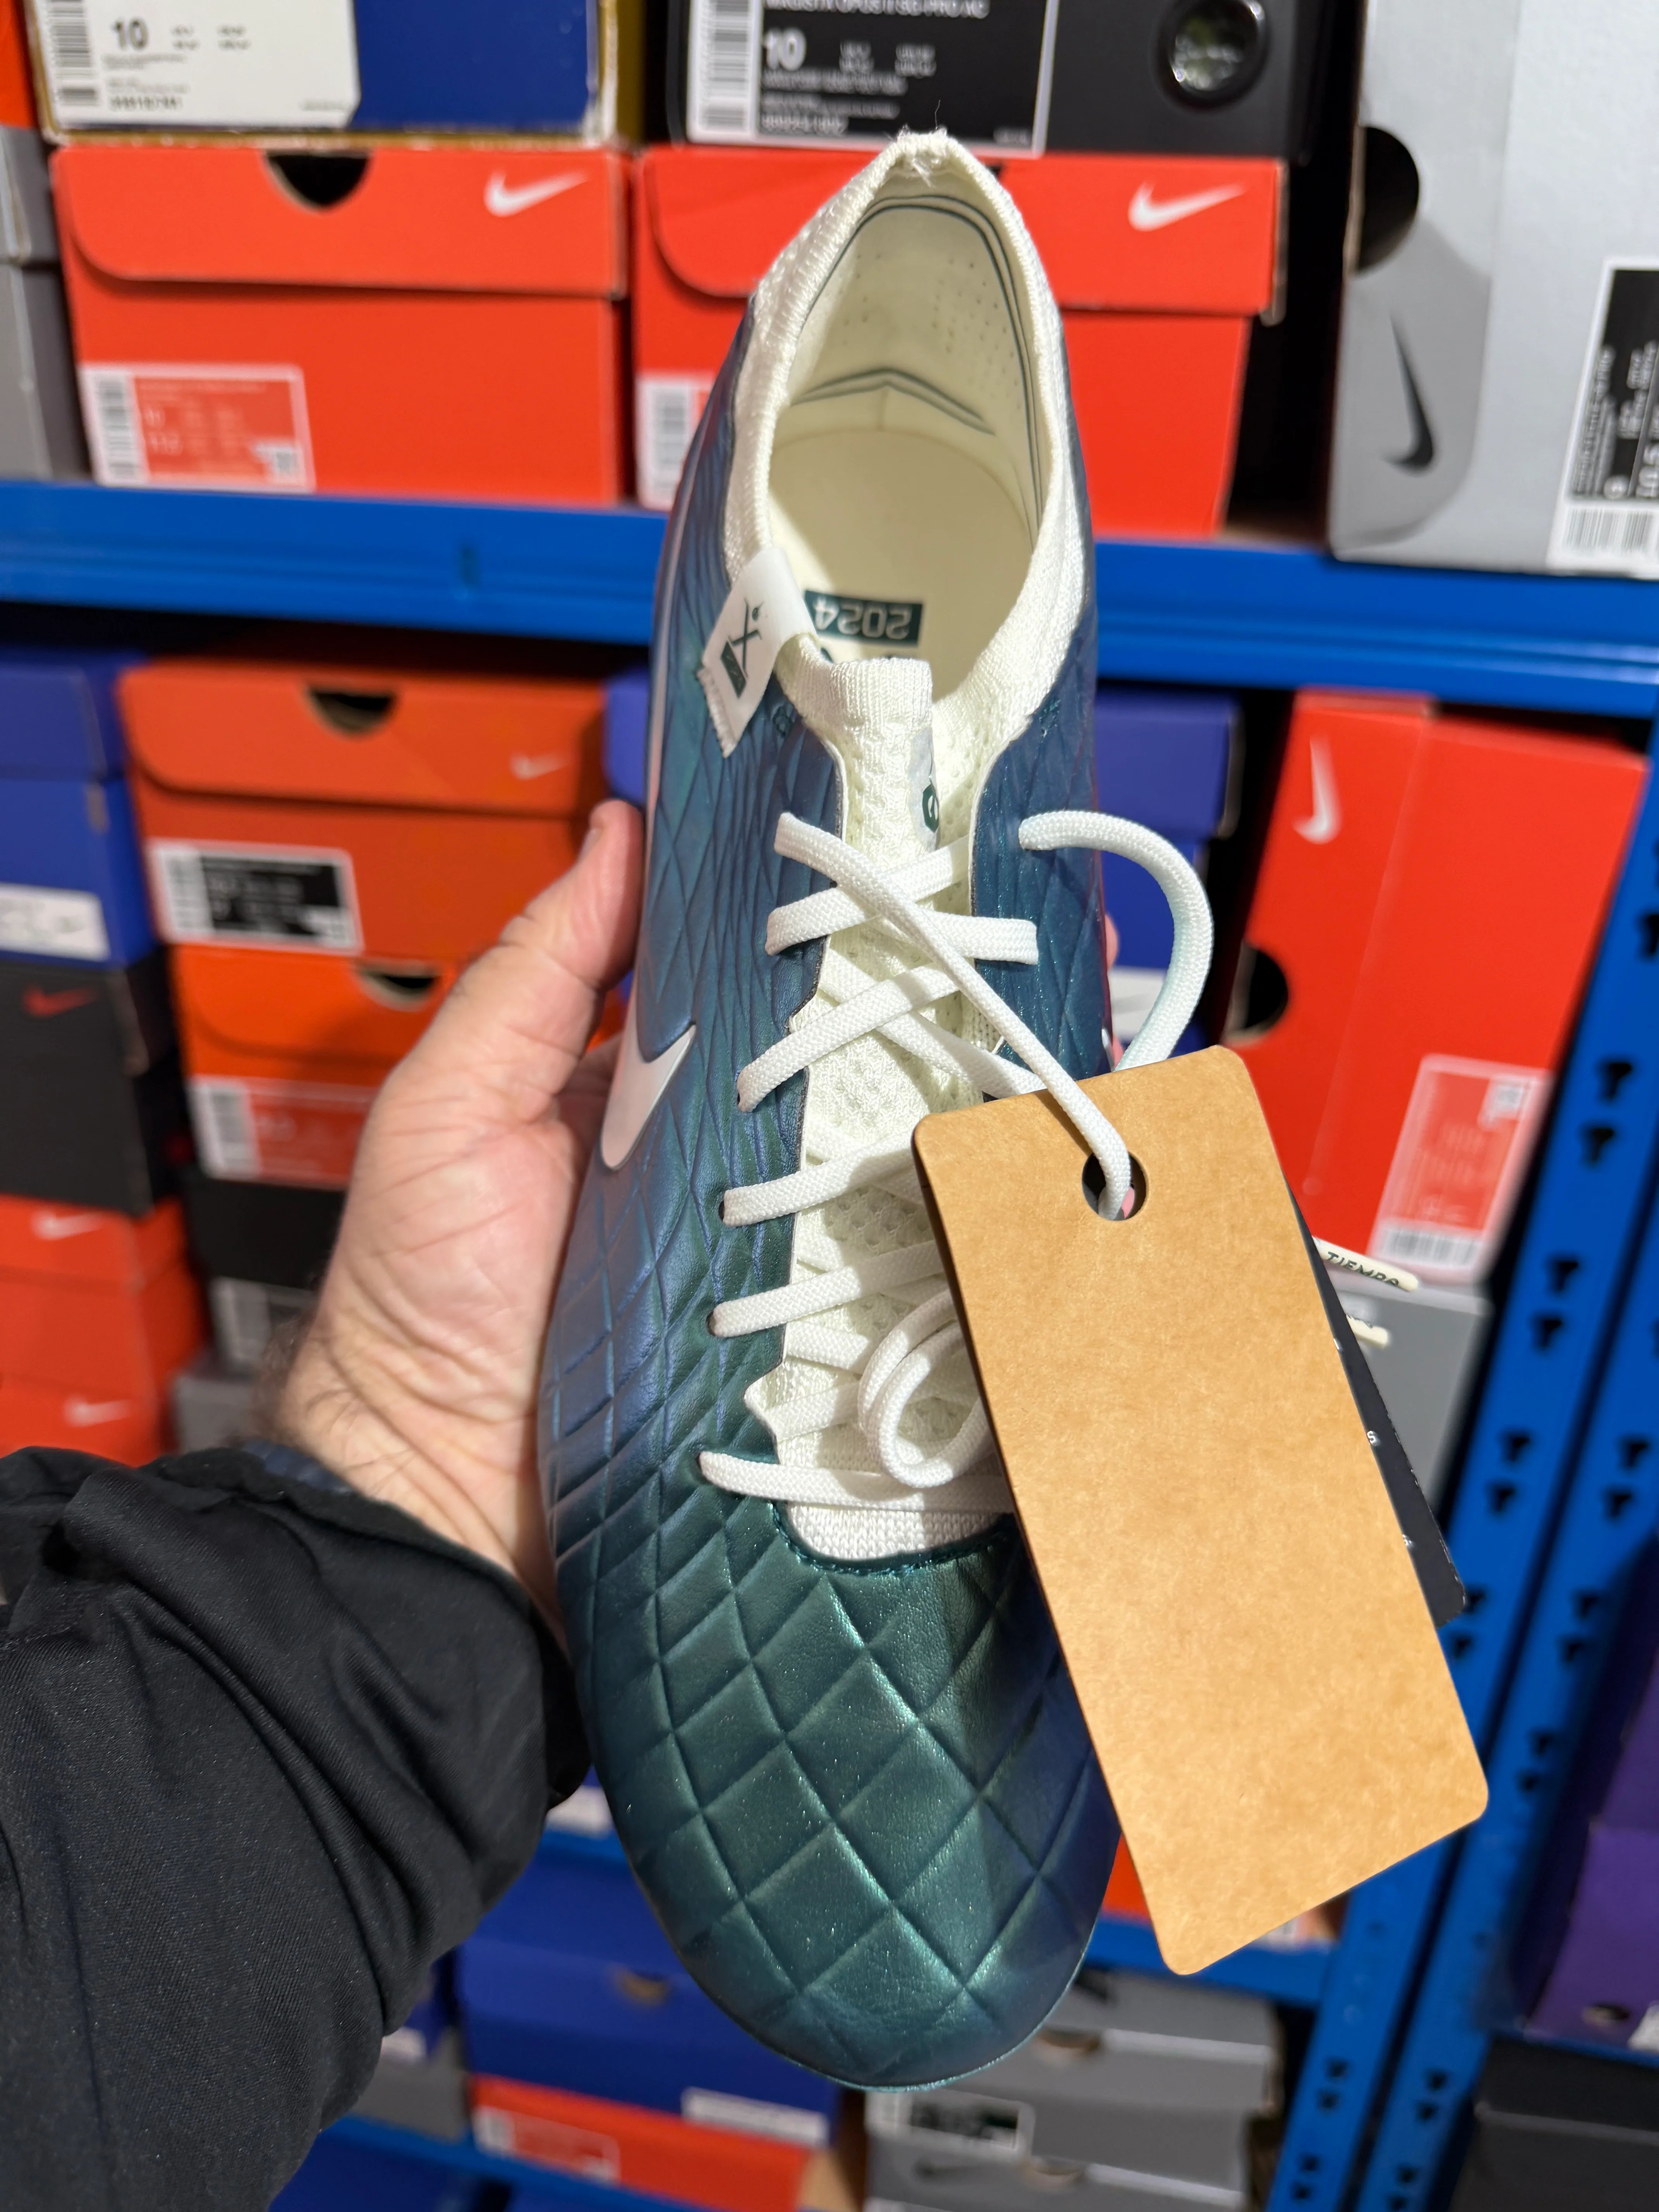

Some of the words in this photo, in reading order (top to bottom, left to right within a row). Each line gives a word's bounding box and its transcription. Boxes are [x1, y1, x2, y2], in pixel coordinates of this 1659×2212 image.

[113, 18, 149, 50] 10
[763, 28, 807, 71] 10
[812, 594, 913, 640] 2024
